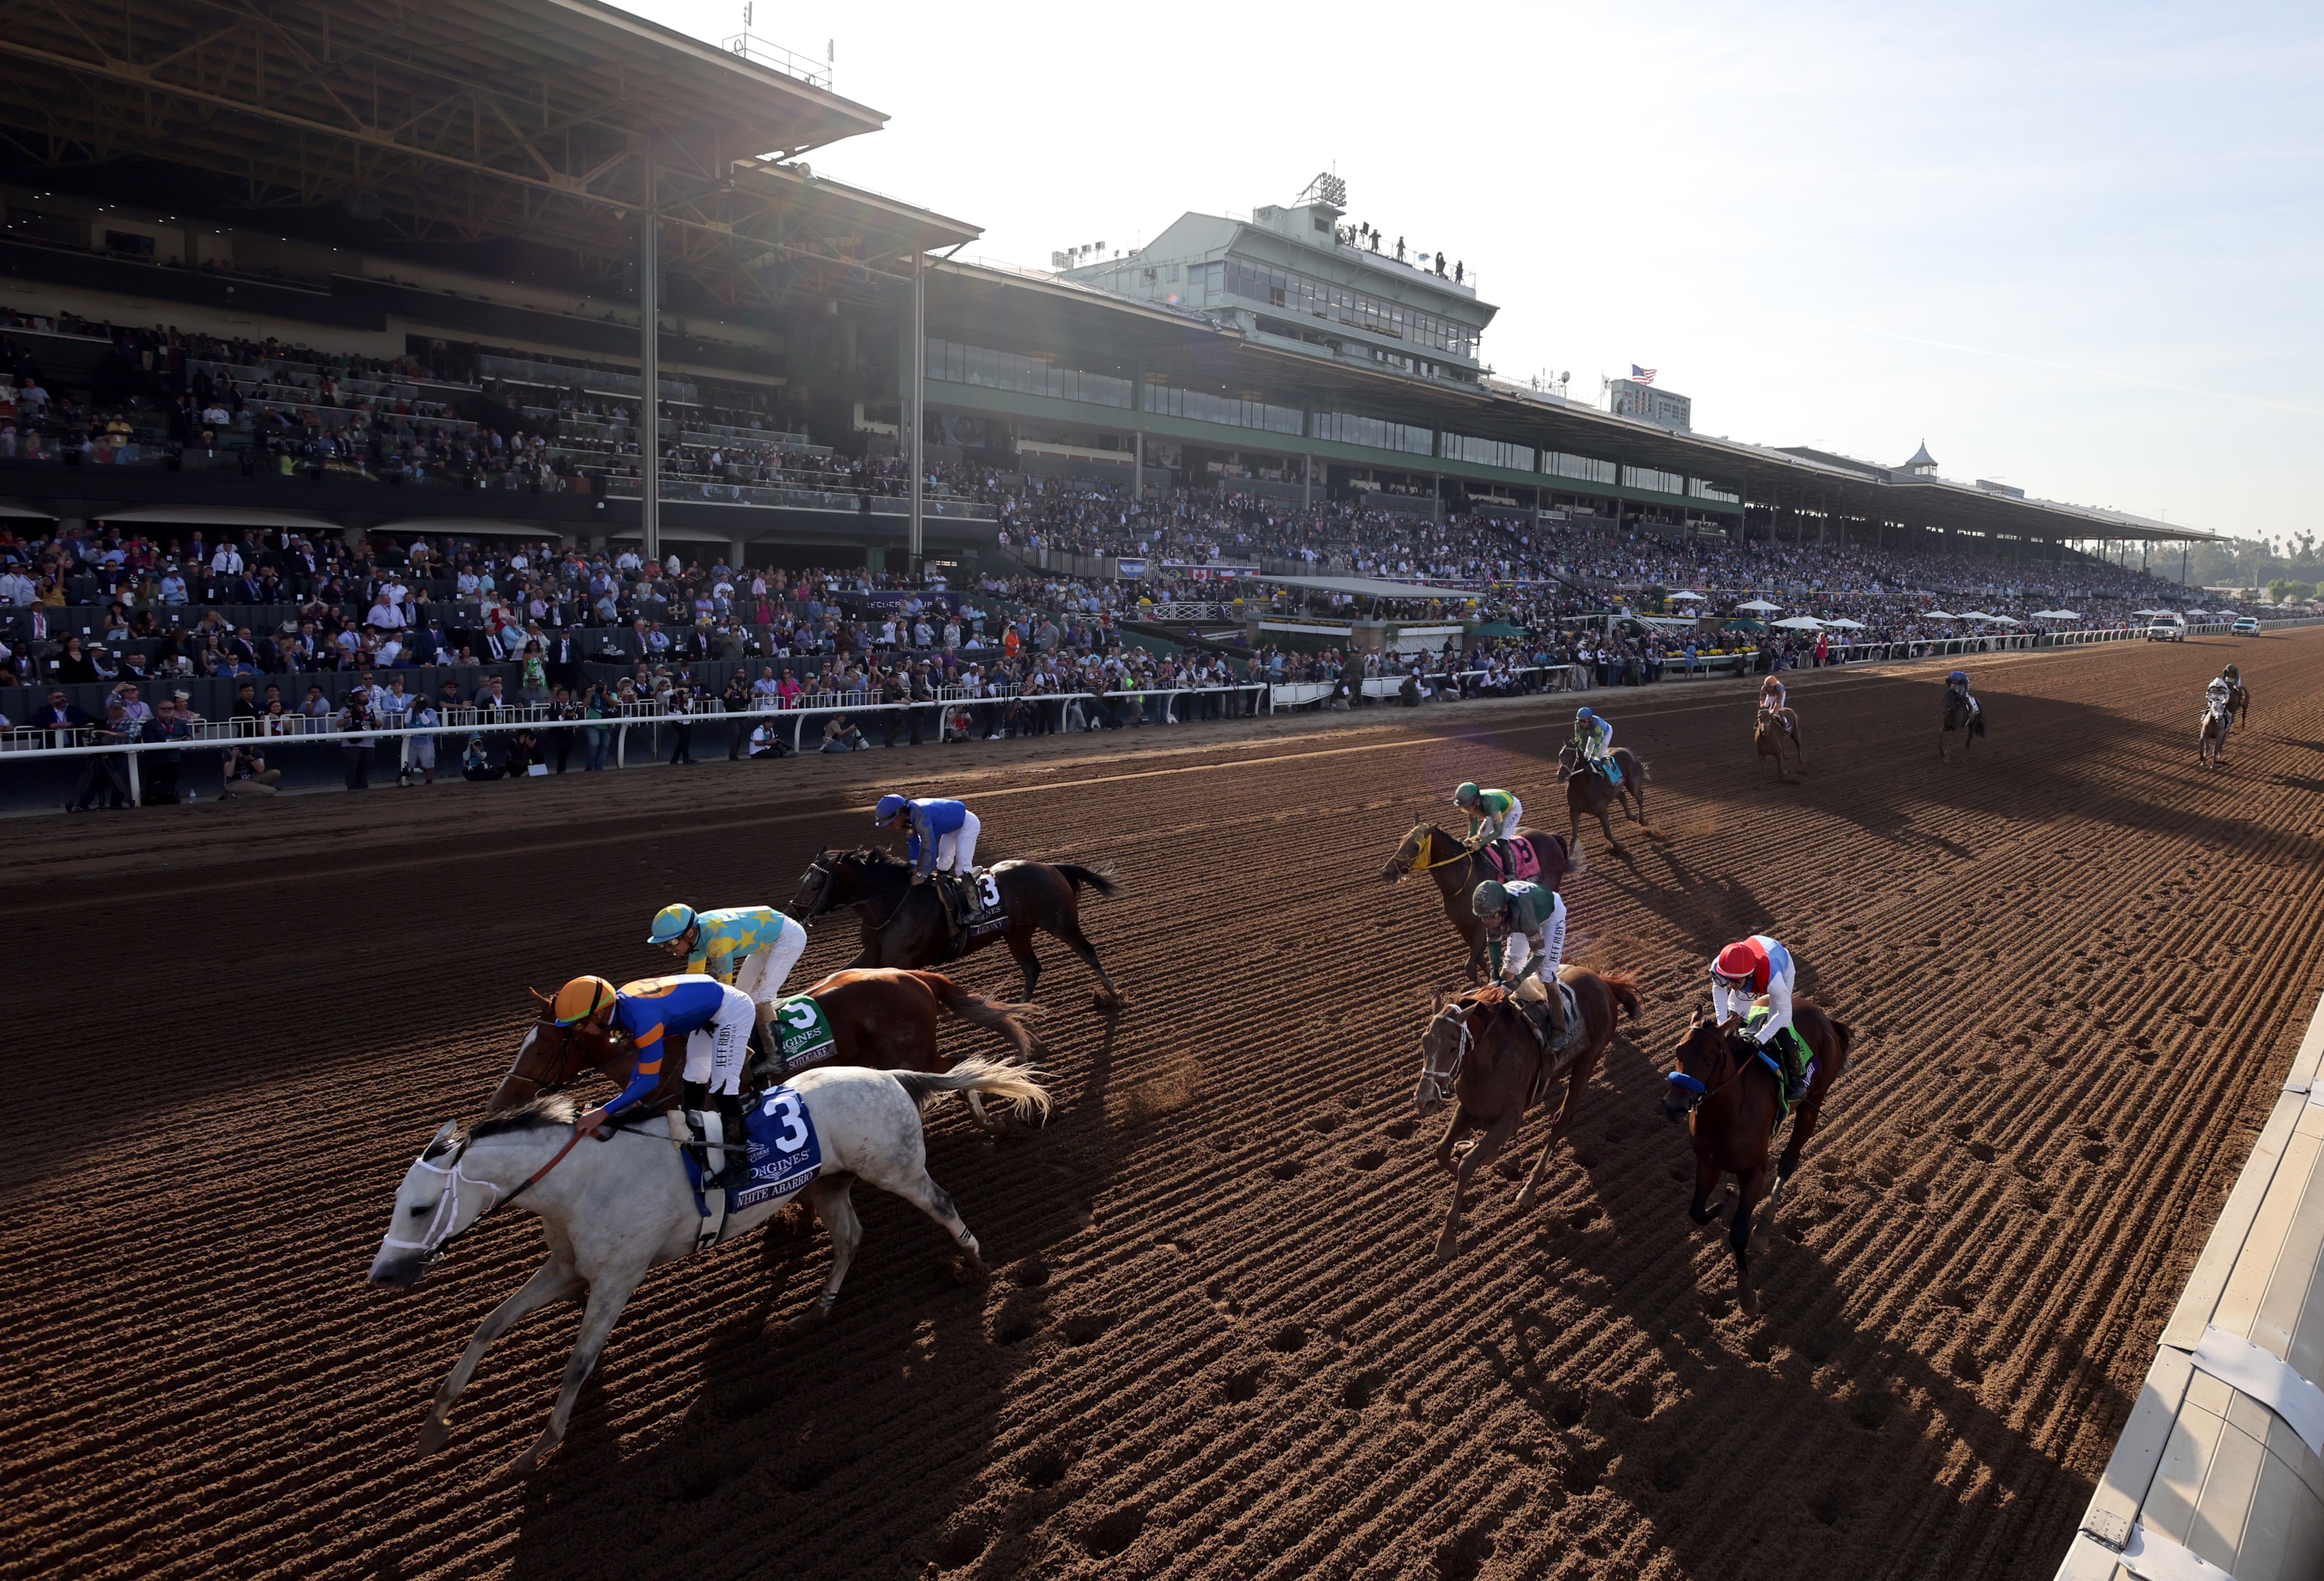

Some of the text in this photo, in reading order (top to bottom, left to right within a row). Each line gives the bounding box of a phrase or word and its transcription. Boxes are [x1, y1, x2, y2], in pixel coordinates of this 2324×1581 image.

[1549, 943, 1560, 964] JEFF
[716, 1047, 727, 1068] JEFF
[788, 1047, 828, 1070] SOTOGAKE
[762, 1096, 809, 1154] 3
[750, 1150, 809, 1179] ONGINES
[771, 1171, 813, 1196] ABARRIO
